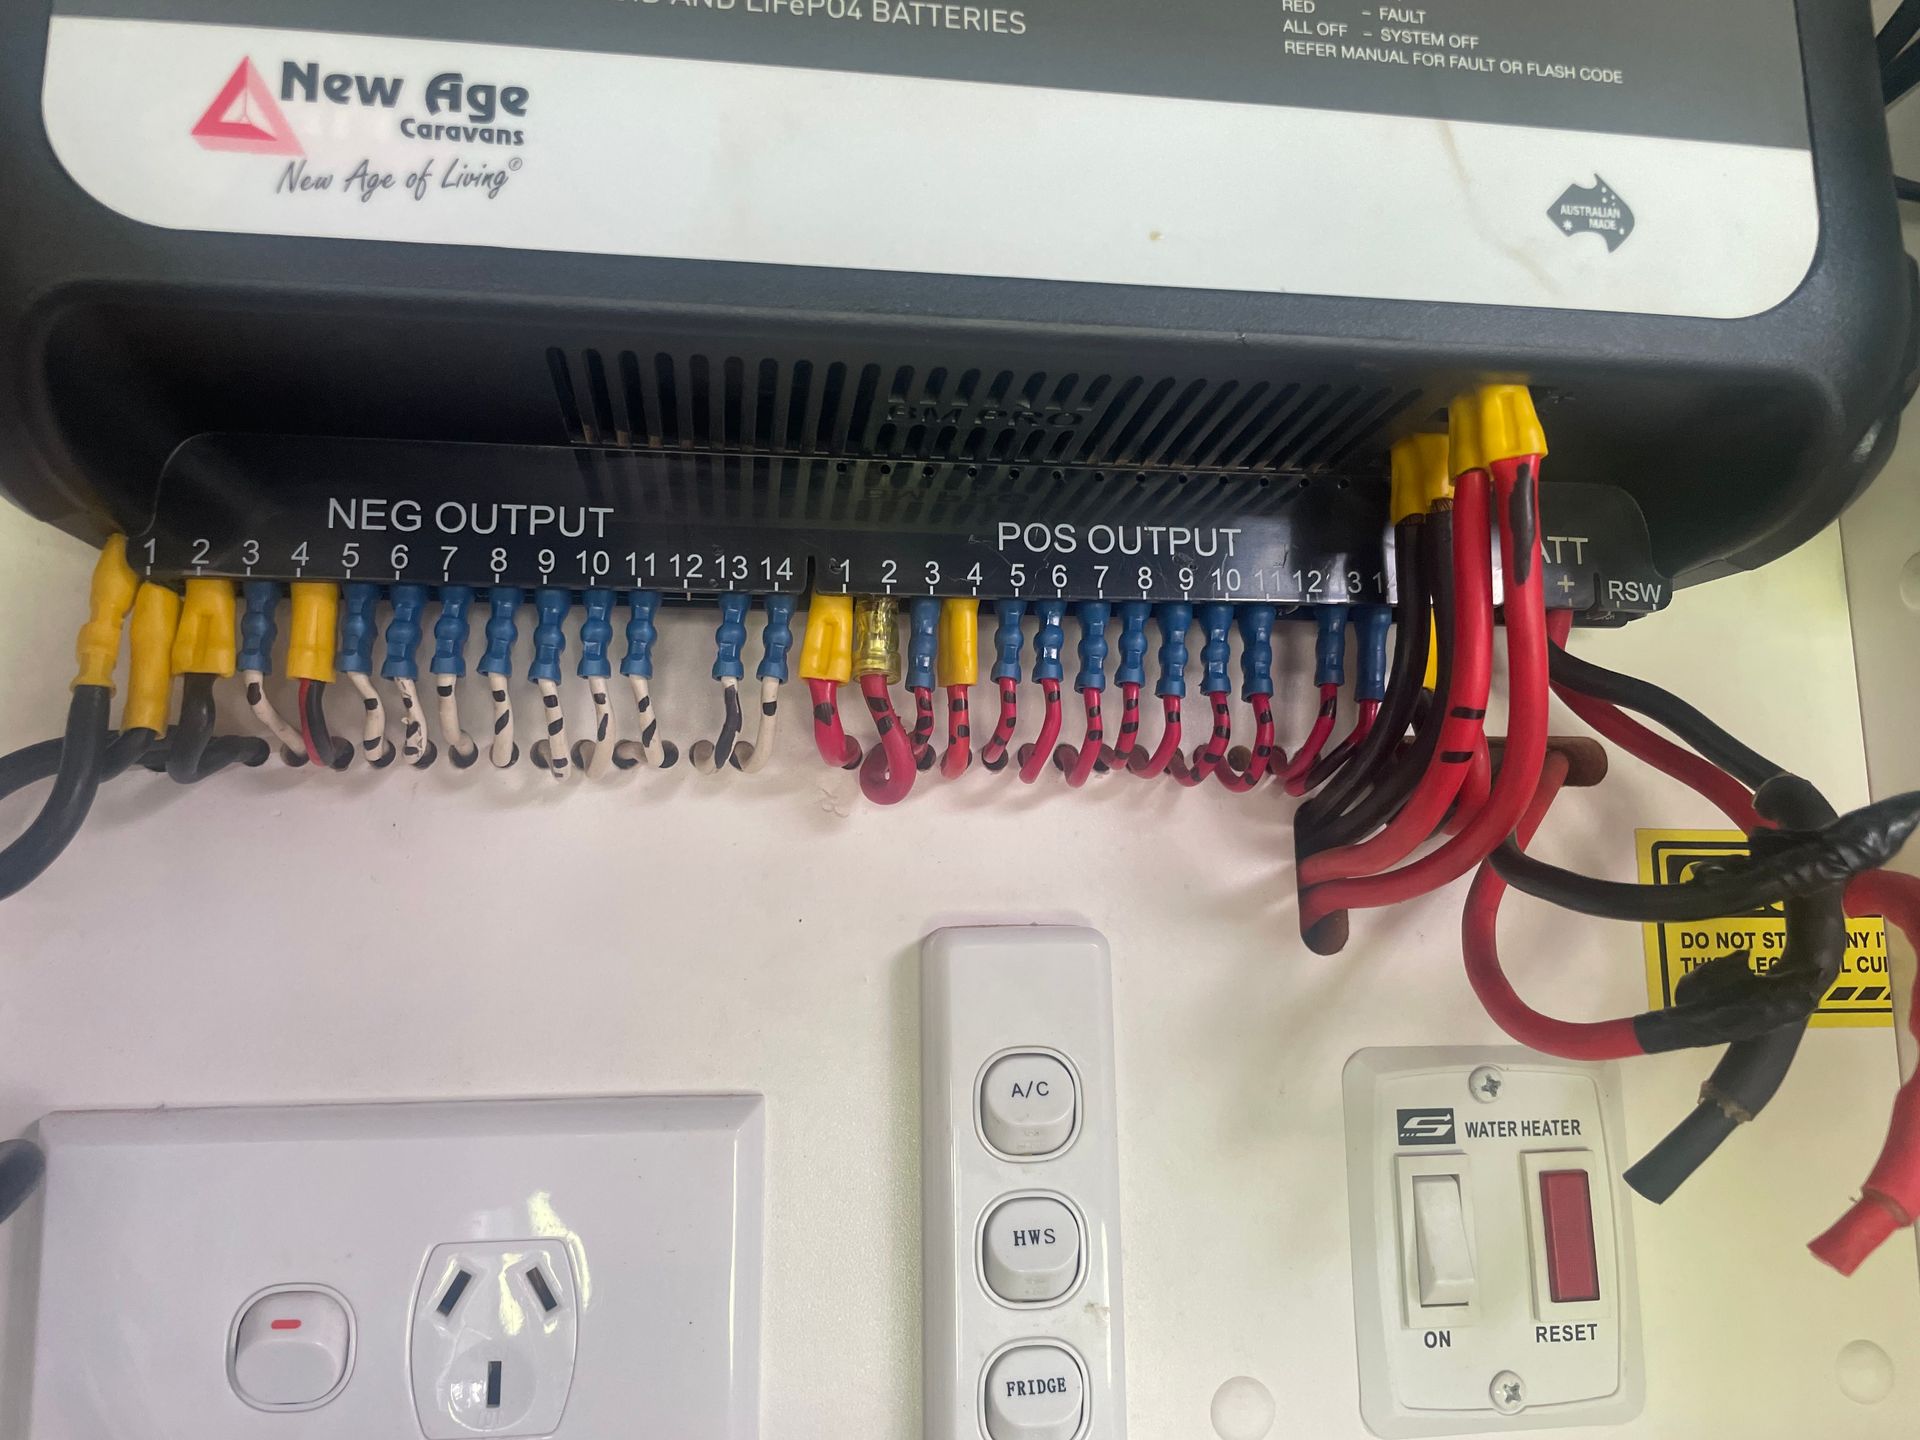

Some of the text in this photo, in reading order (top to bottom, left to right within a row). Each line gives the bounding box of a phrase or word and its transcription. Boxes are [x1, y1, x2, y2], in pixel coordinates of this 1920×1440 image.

[872, 0, 1027, 35] BATTERIES
[1282, 0, 1315, 13] RED
[1379, 7, 1426, 25] FAULT
[1283, 19, 1312, 35] ALL
[1317, 22, 1348, 37] OFF
[1380, 27, 1444, 47] SYSTEM
[1449, 34, 1480, 50] OFF
[1284, 40, 1624, 84] REFER MANUAL FOR FAULT OR FLASH CODE
[280, 60, 530, 124] New Age
[400, 118, 525, 146] Caravans
[275, 159, 333, 194] New
[344, 158, 396, 202] Age
[406, 159, 432, 201] of
[328, 497, 614, 538] NEG OUTPUT
[998, 522, 1241, 557] POS OUTPUT
[143, 538, 793, 581] 1 2 3 4 5 6 7 8 9 10 11 12 13 14
[840, 559, 850, 583] 1
[881, 559, 897, 584] 2
[925, 561, 940, 585] 3
[966, 562, 983, 586] 4
[1010, 564, 1025, 587] 5
[1052, 564, 1067, 588] 6
[1094, 565, 1109, 588] 7
[1137, 566, 1152, 590] 8
[1178, 567, 1194, 591] 9
[1211, 568, 1241, 591] 10
[1254, 568, 1280, 592] 11
[1292, 569, 1323, 593] 12
[1608, 580, 1662, 604] RSW
[1681, 931, 1709, 949] DO
[1716, 931, 1756, 949] NOT
[1011, 1080, 1050, 1098] A/C
[1465, 1119, 1581, 1138] WATER HEATER
[1013, 1228, 1056, 1247] HWS
[1424, 1331, 1451, 1348] ON
[1536, 1324, 1598, 1342] RESET
[1006, 1377, 1067, 1397] FRIDGE
